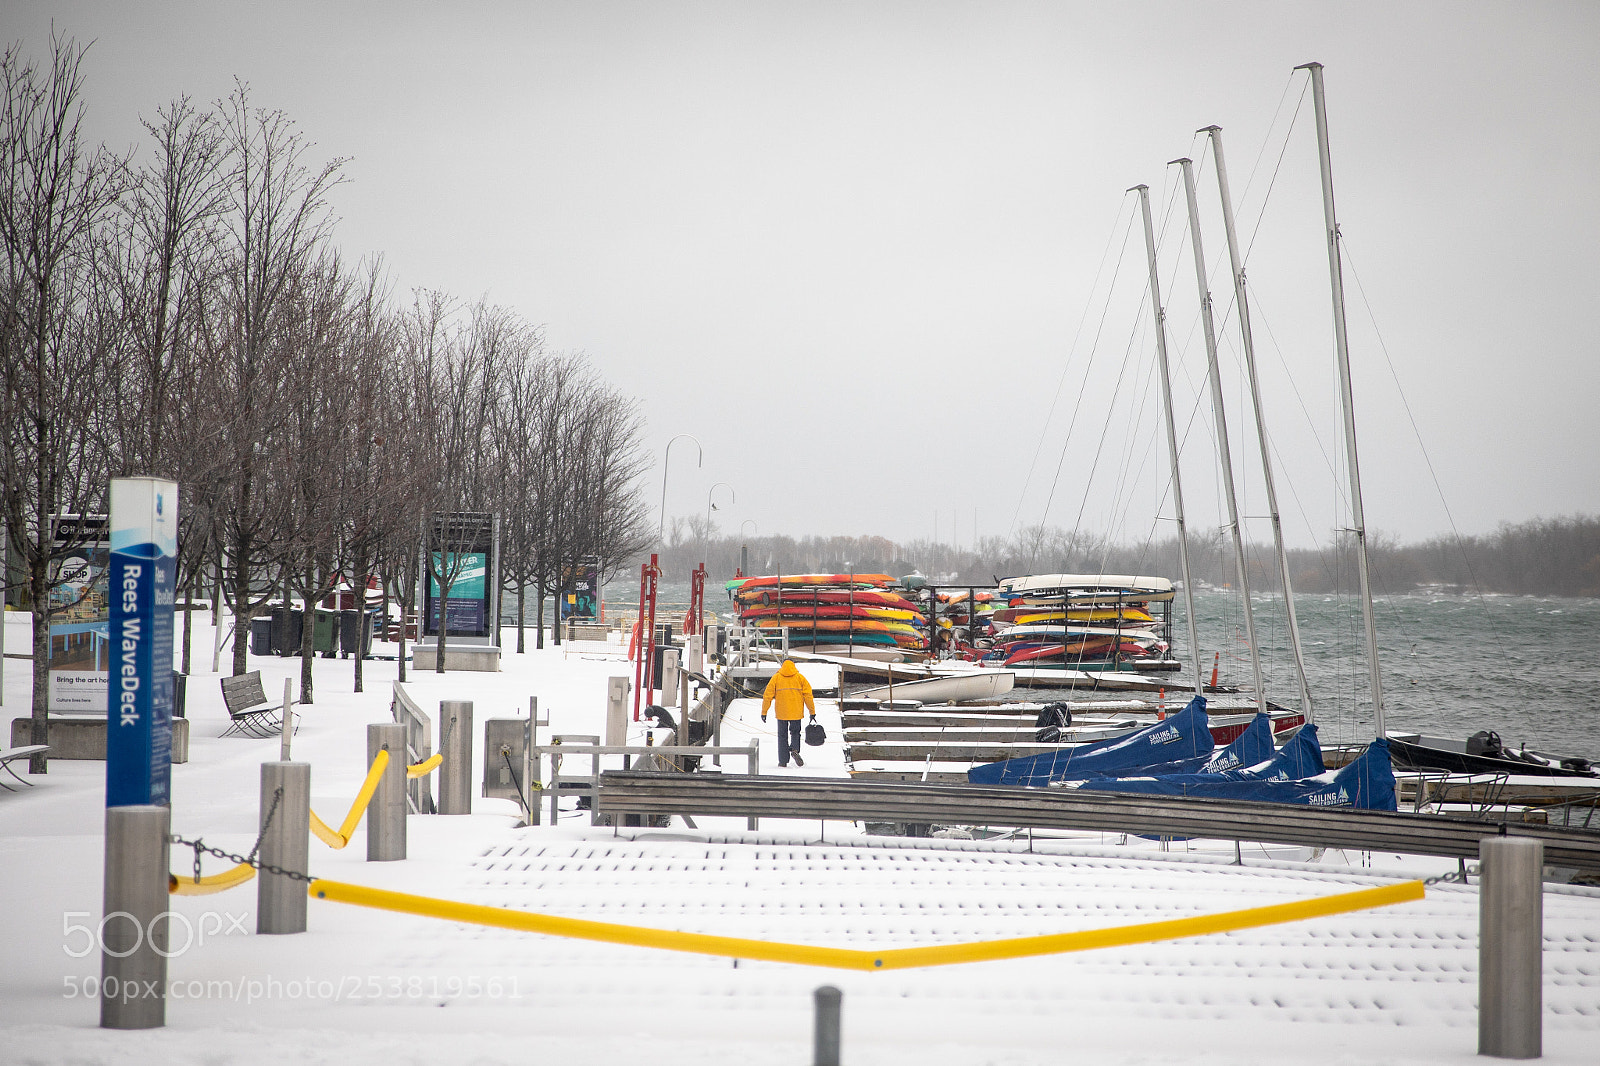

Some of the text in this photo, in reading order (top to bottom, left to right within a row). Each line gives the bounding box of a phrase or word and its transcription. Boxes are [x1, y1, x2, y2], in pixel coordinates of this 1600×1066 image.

[63, 570, 88, 579] SHOP
[120, 564, 142, 727] Rees WaveDeck
[56, 676, 74, 684] Bring
[1148, 730, 1171, 741] SAILING
[1308, 792, 1337, 803] SAILING
